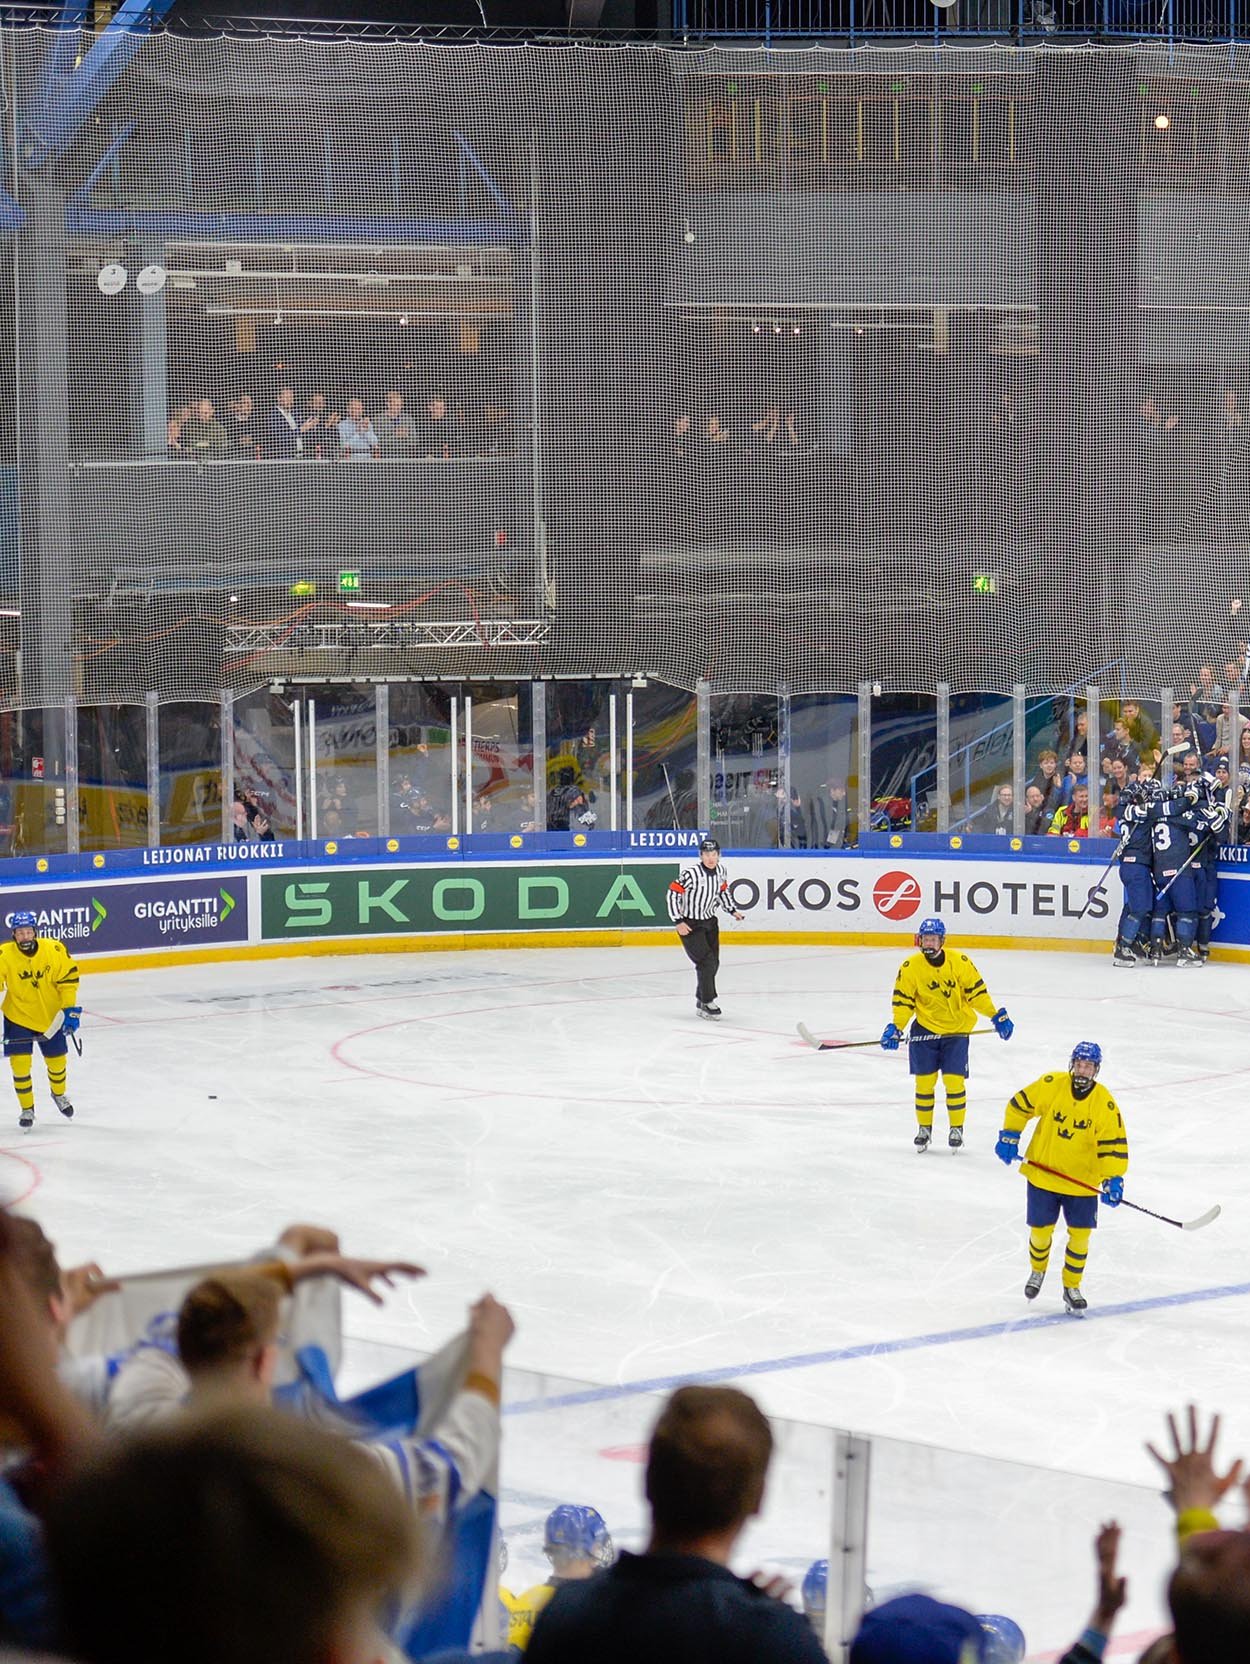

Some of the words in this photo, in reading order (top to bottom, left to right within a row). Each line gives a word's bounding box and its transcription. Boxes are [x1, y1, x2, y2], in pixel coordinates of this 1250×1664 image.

[630, 832, 709, 847] LEIJONAT
[143, 847, 212, 865] LEIJONAT
[217, 843, 284, 861] RUOKKII
[1214, 847, 1248, 863] KKII
[134, 897, 218, 919] GIGANTTI
[729, 878, 861, 911] OKOS
[934, 880, 1110, 919] HOTELS
[4, 906, 90, 929] GANTTI
[159, 913, 218, 935] yrityksille
[37, 922, 91, 940] rityksille
